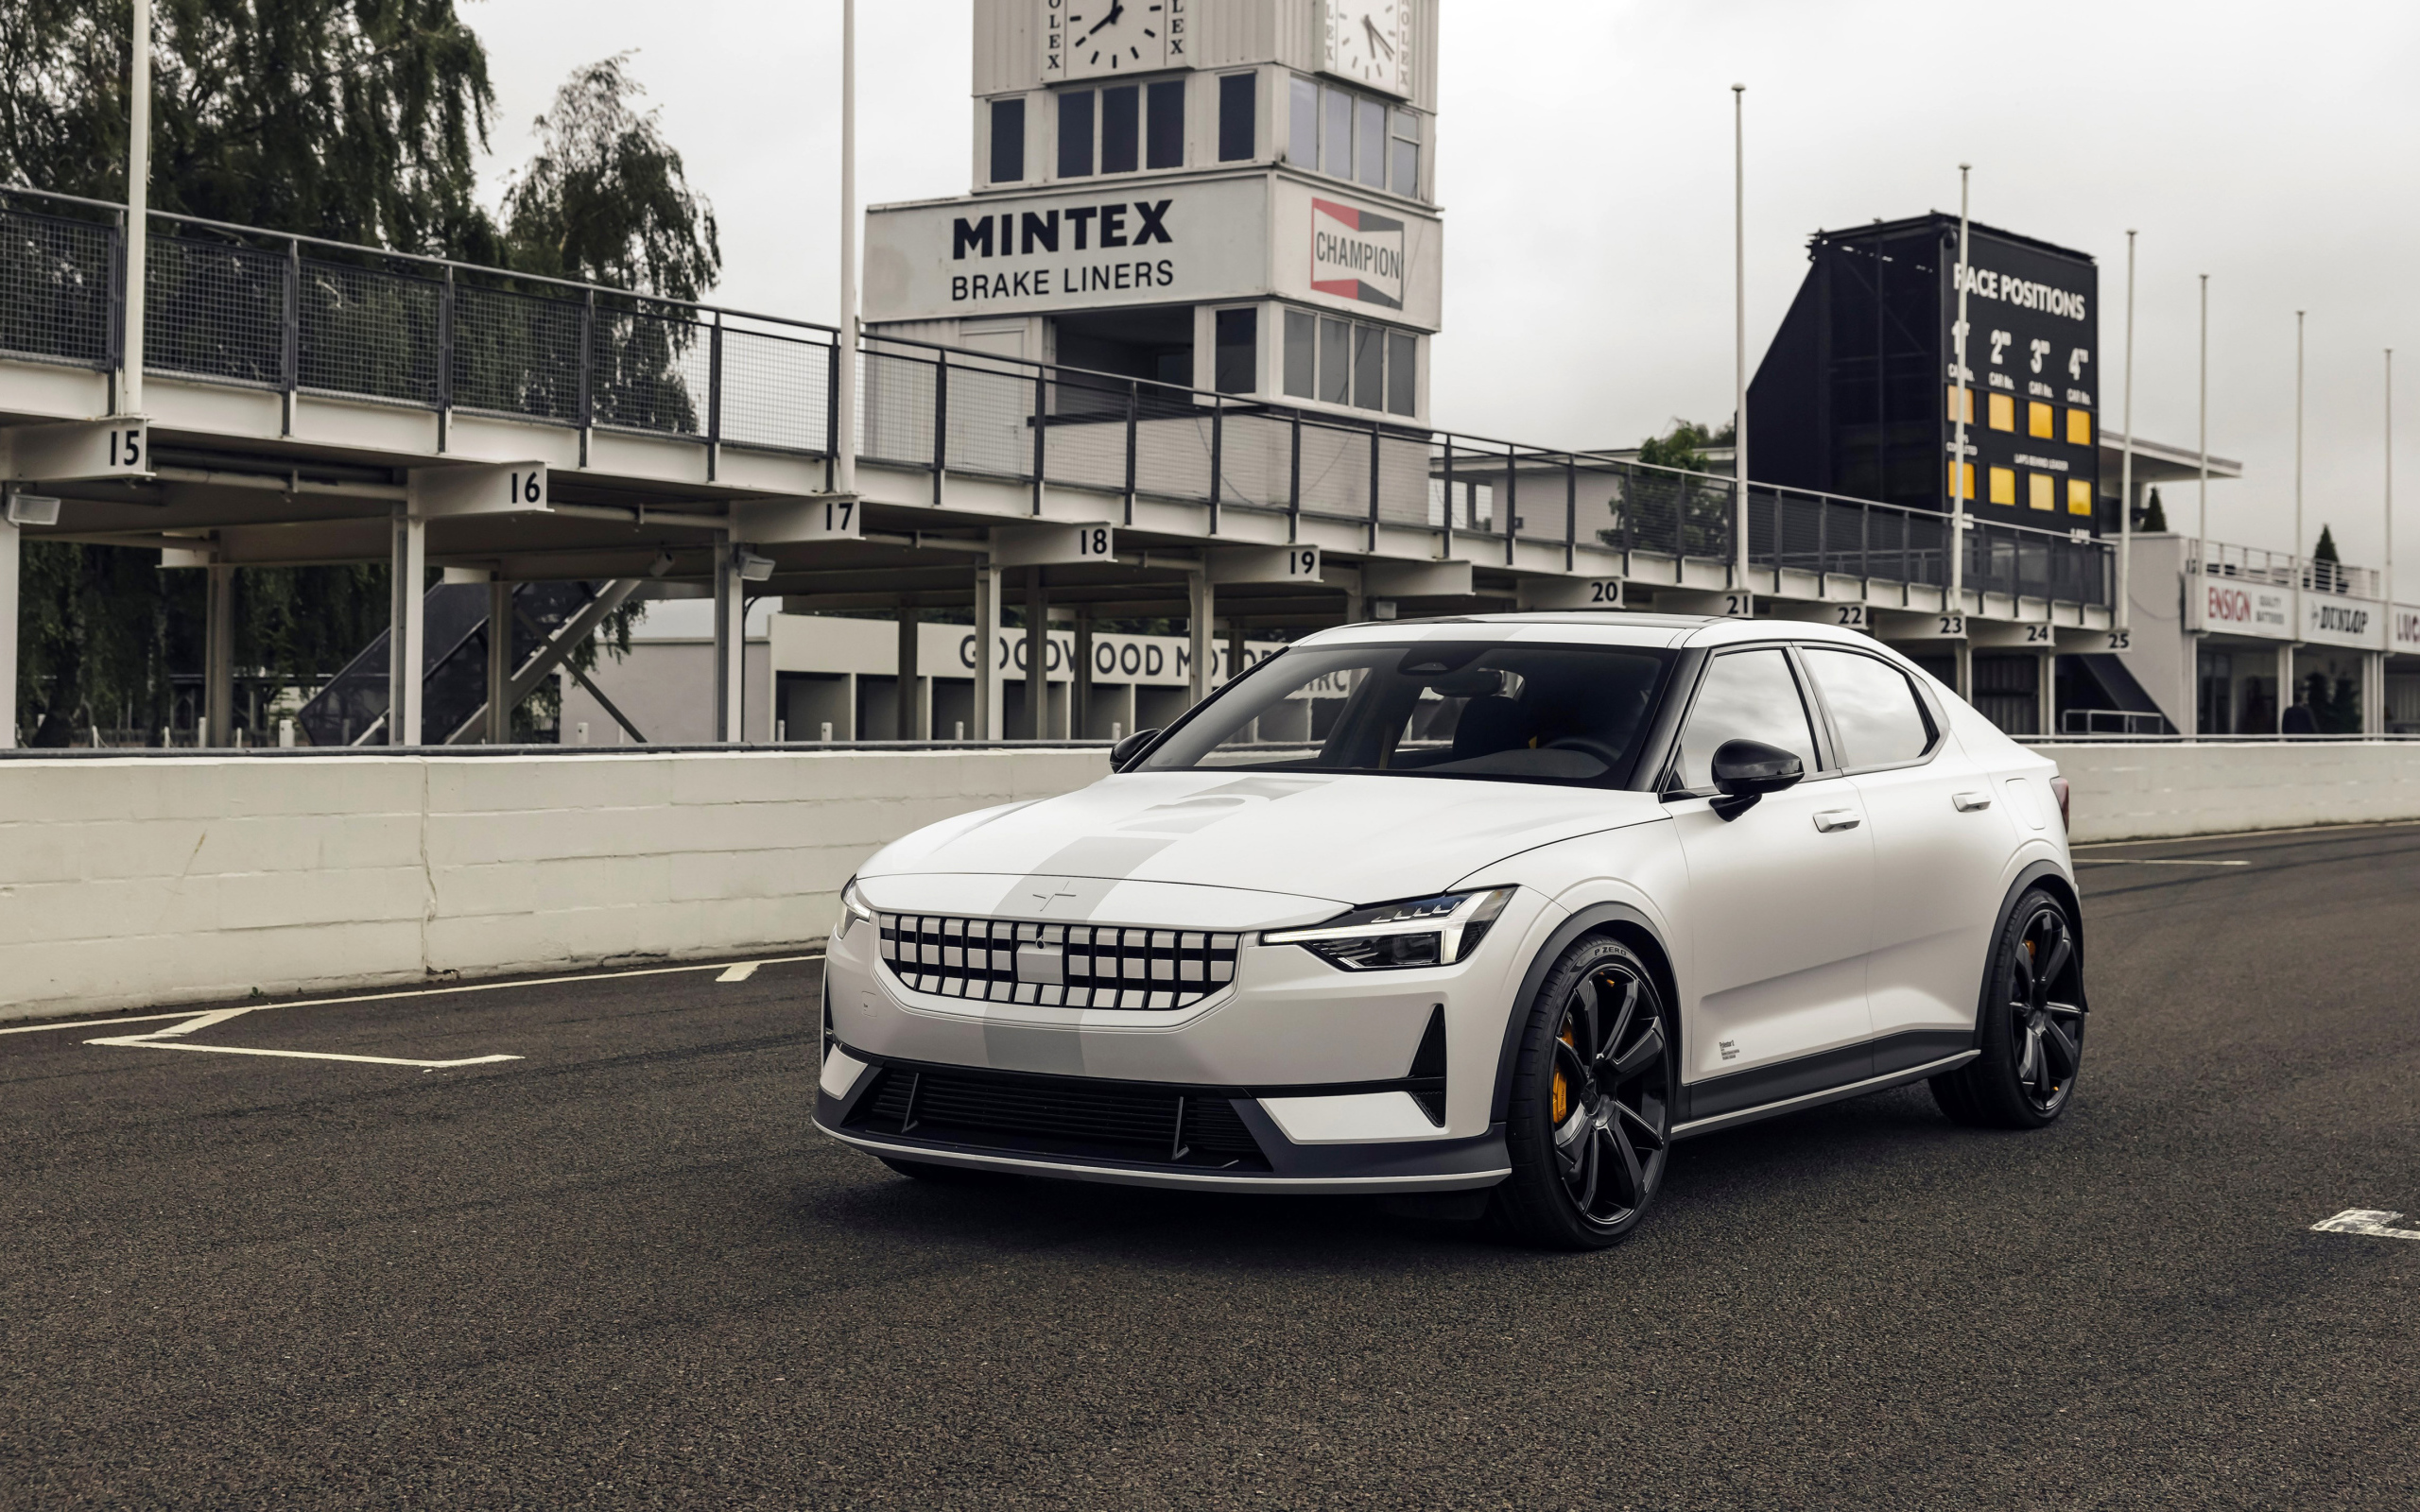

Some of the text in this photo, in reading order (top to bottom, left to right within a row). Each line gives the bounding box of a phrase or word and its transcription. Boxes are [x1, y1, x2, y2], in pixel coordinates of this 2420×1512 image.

[953, 198, 1174, 260] MINTEX
[1316, 231, 1400, 280] CHAMPION
[952, 260, 1174, 301] BRAKE LINERS
[2000, 274, 2086, 321] POSITIONS
[110, 430, 139, 466] 15
[511, 471, 541, 504] 16
[826, 502, 854, 531] 17
[1080, 528, 1107, 555] 18
[1290, 550, 1315, 575] 19
[1591, 581, 1618, 602] 20
[1726, 595, 1748, 614] 21
[2208, 586, 2252, 623] ENSIGN
[1838, 607, 1862, 624] 22
[1940, 616, 1962, 634] 23
[2320, 606, 2369, 634] DUNLOP
[2027, 625, 2048, 642] 24
[2108, 632, 2130, 648] 25
[1601, 946, 1627, 956] ZERO
